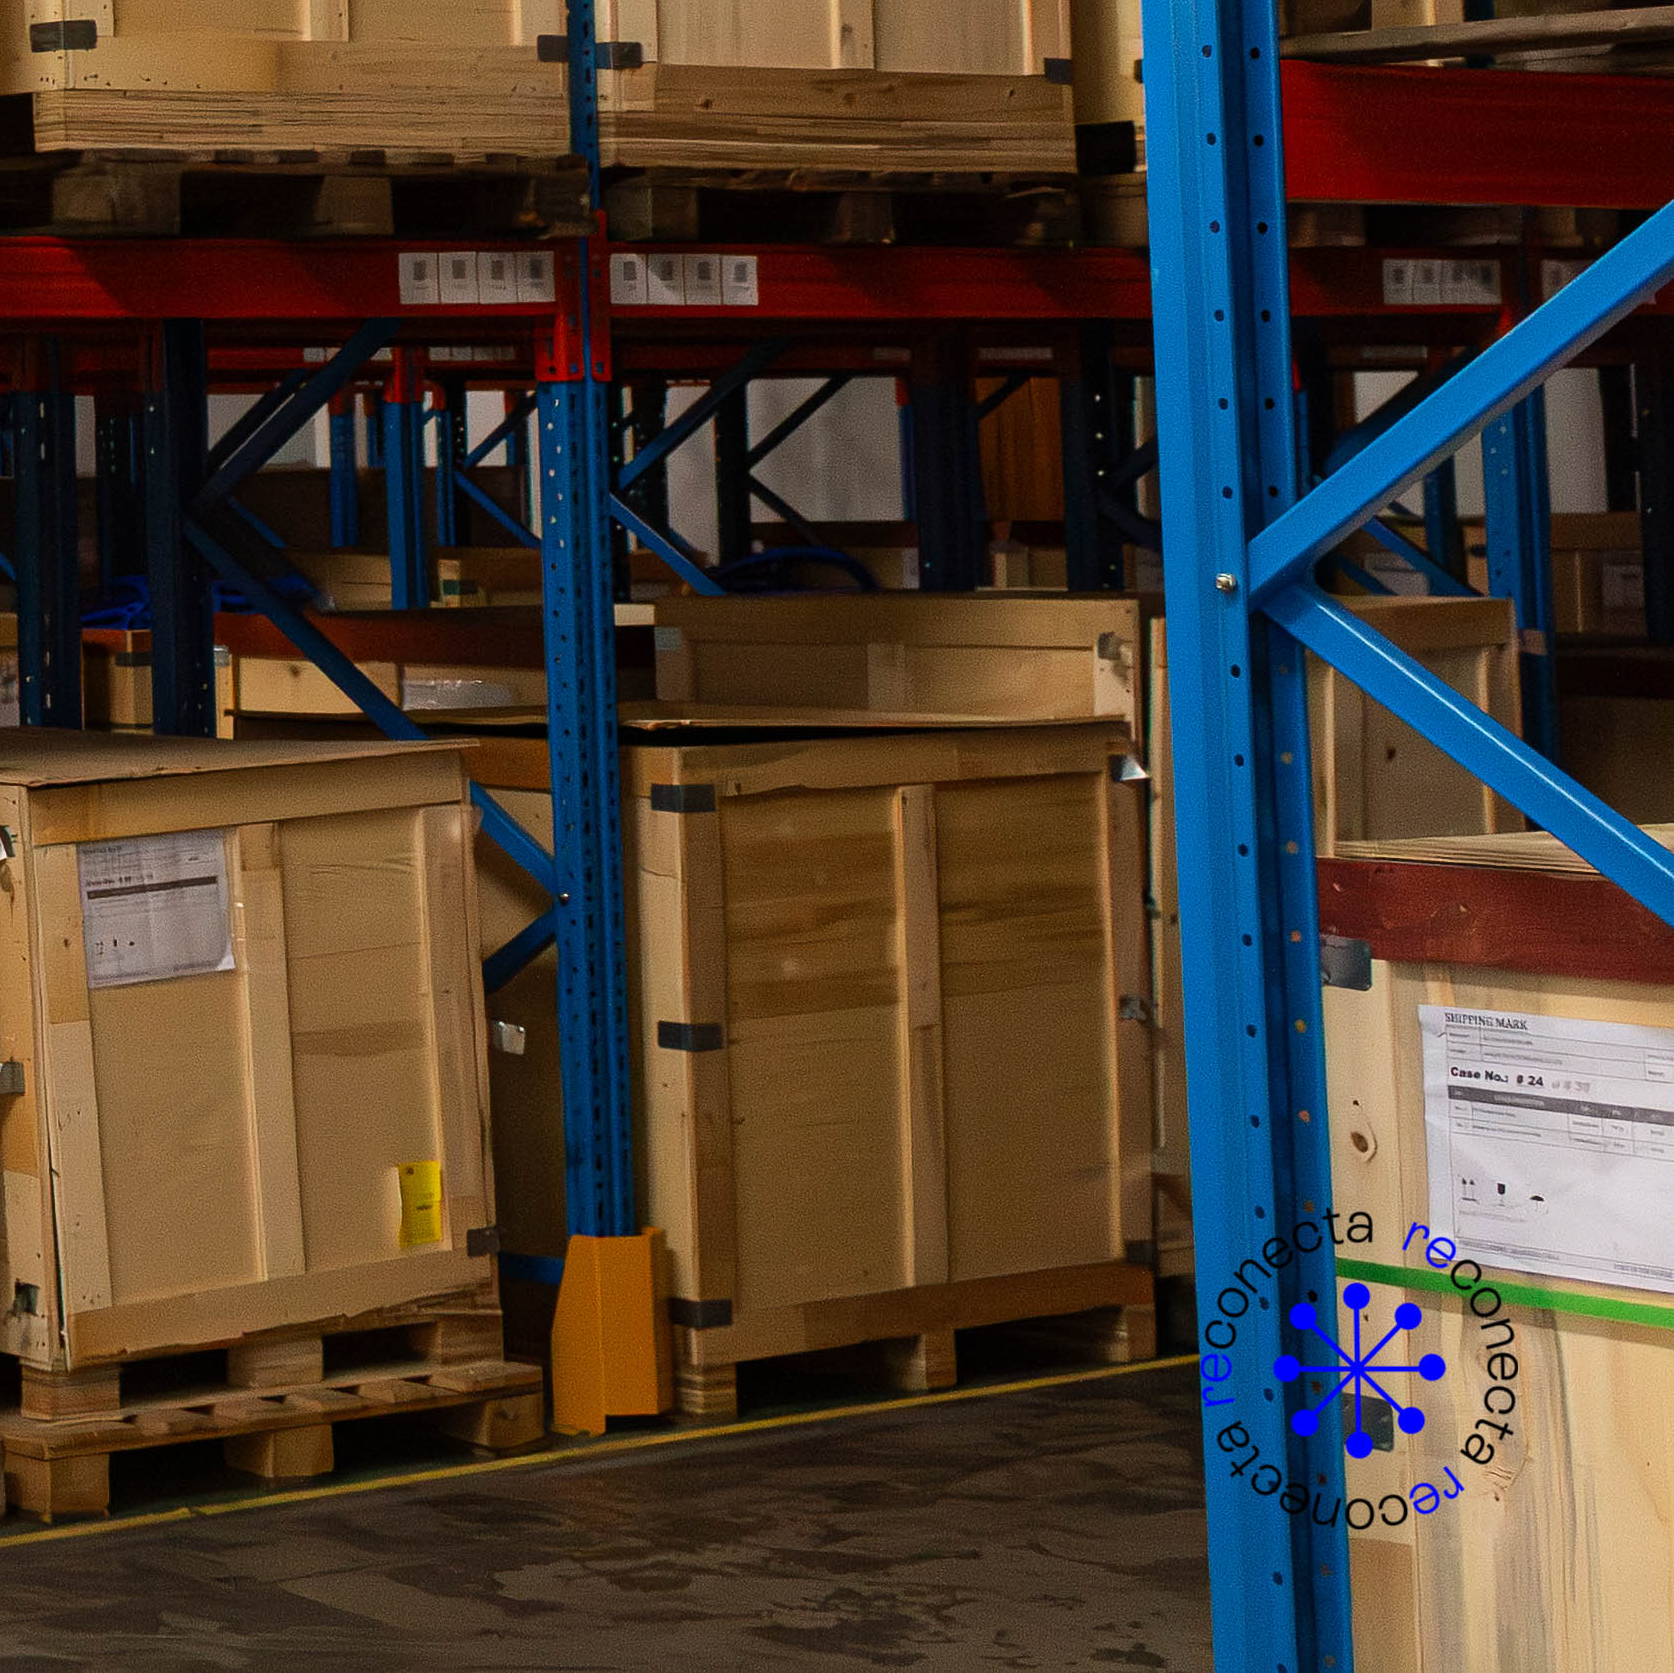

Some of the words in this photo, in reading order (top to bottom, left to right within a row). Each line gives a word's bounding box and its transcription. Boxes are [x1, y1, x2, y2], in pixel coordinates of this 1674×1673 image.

[1445, 1013, 1494, 1028] SHIPPING
[1495, 1017, 1528, 1030] MARK
[1450, 1066, 1481, 1079] Case
[1527, 1075, 1544, 1086] 24
